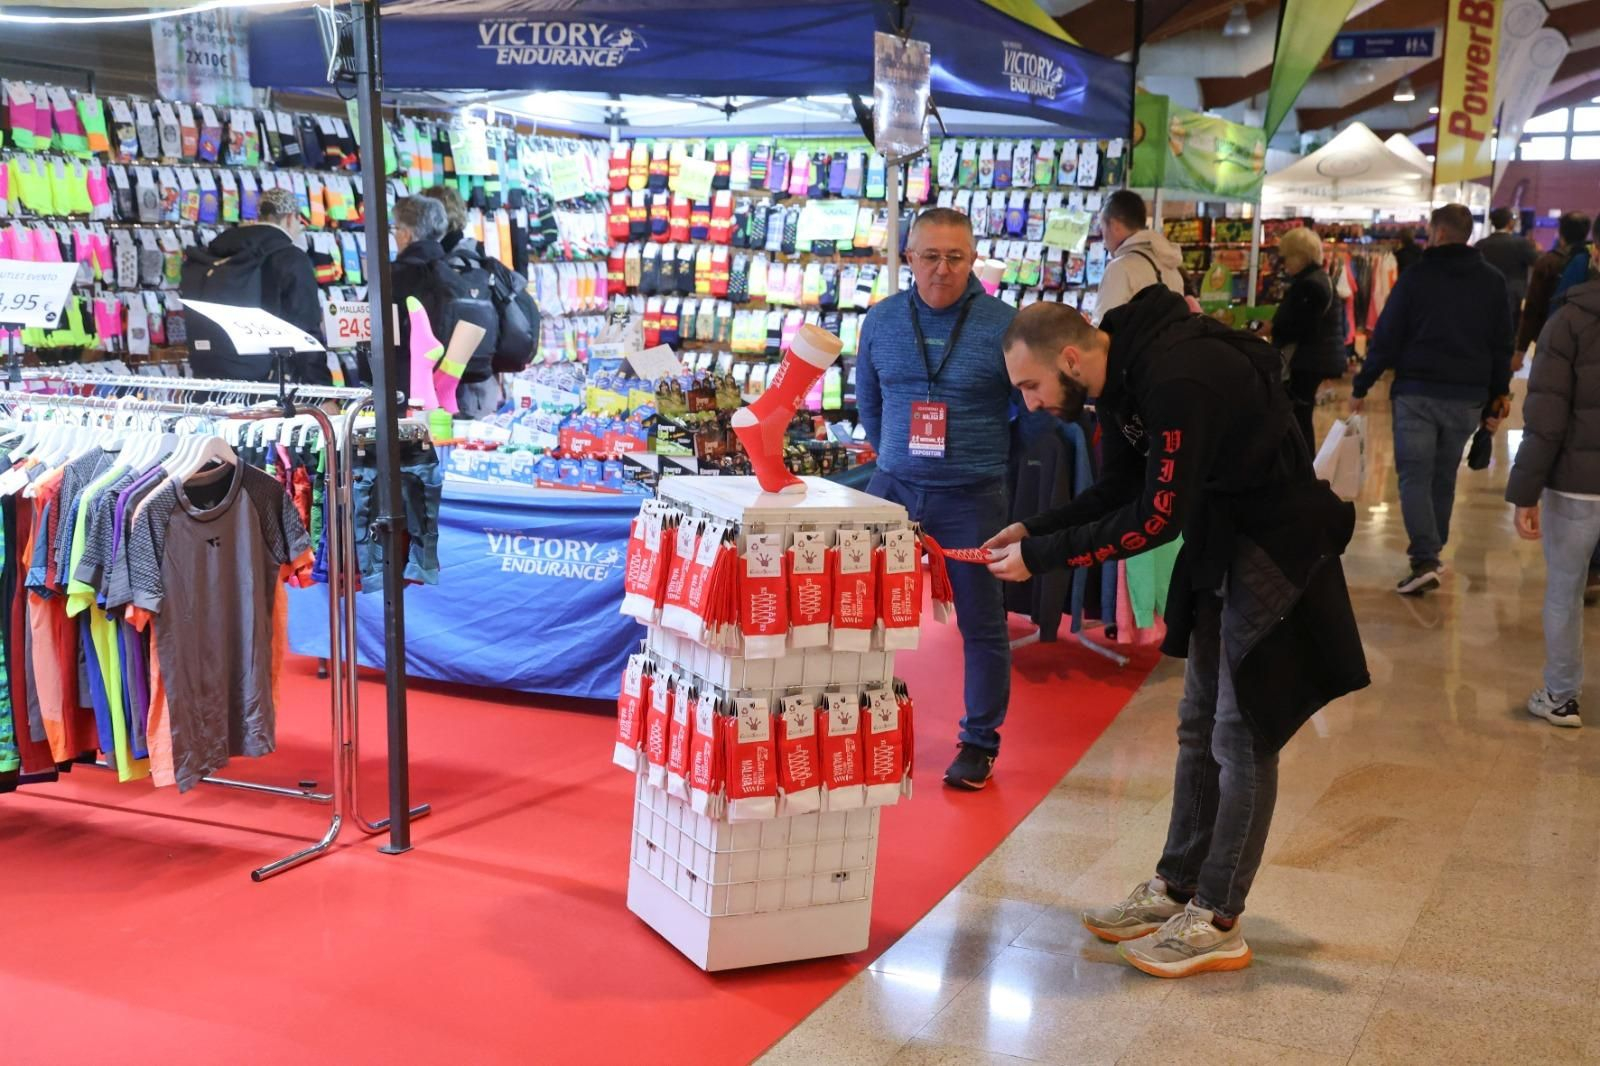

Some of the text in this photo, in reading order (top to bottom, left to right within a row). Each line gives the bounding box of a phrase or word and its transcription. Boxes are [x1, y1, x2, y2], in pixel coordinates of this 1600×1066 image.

[478, 22, 608, 47] VICTORY
[496, 48, 619, 67] ENDURANCE
[1004, 49, 1054, 80] VICTORY
[1447, 0, 1496, 142] PowerB
[1010, 76, 1056, 100] ENDURANCE
[0, 271, 26, 280] UTLET
[339, 305, 365, 314] MALLAS
[338, 317, 371, 339] 24,9
[911, 449, 942, 457] EXPOSITOR
[486, 533, 598, 562] VICTORY
[501, 557, 606, 582] ENDURANCE
